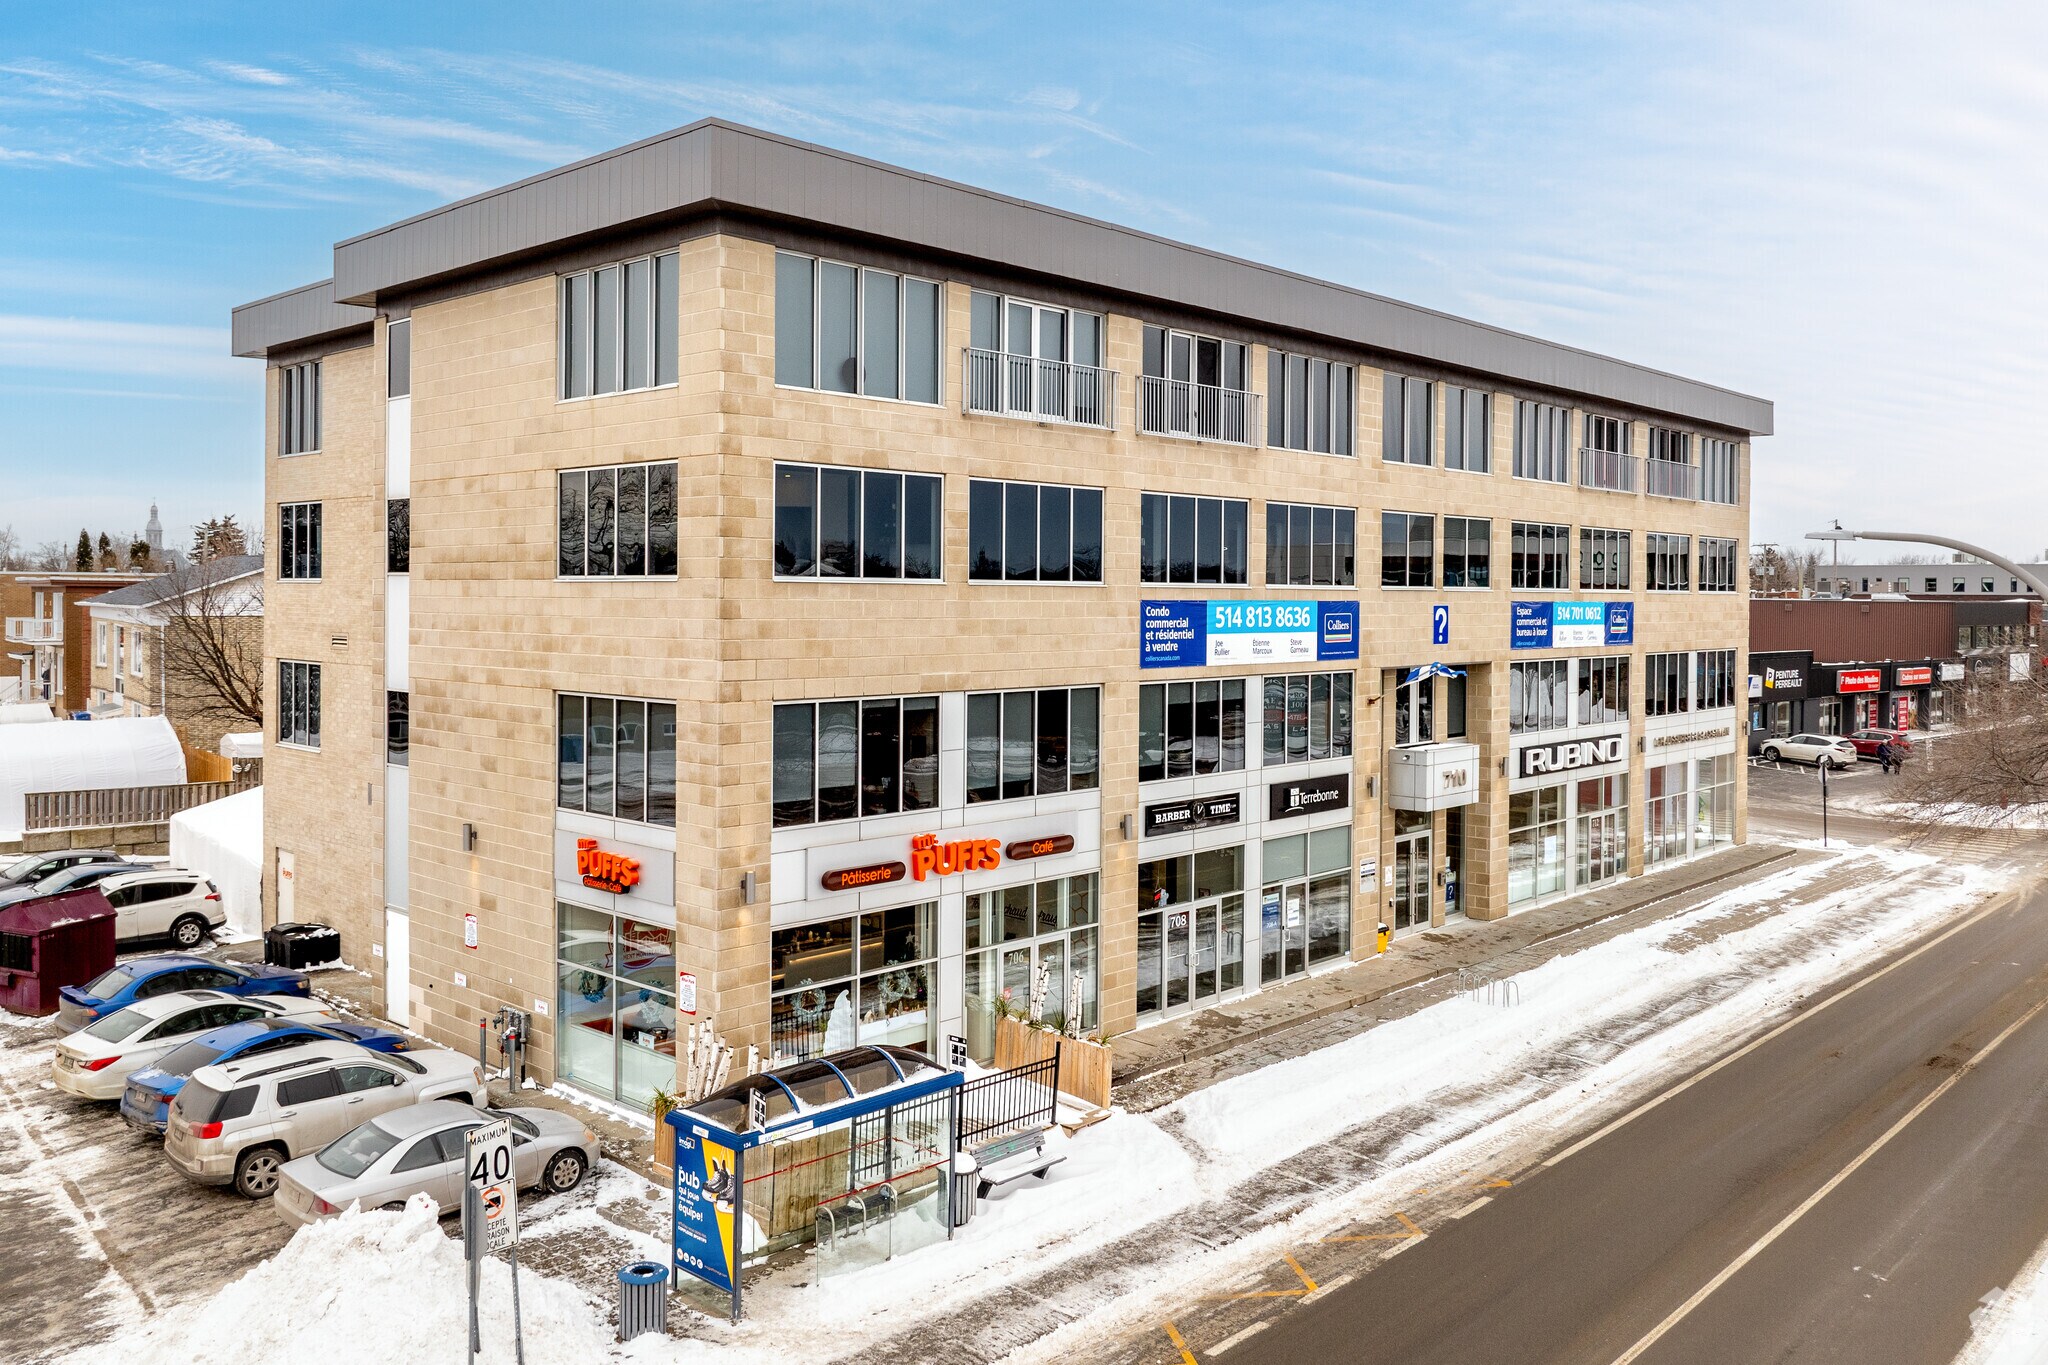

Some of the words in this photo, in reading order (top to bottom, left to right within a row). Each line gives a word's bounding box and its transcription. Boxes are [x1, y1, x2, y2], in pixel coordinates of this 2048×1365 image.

[1146, 606, 1170, 616] Condo
[1215, 606, 1242, 628] 514
[1246, 606, 1272, 628] 813
[1276, 606, 1310, 627] 8636
[1516, 607, 1532, 617] Espace
[1558, 607, 1570, 620] 514
[1572, 607, 1583, 620] 701
[1585, 607, 1601, 620] 0612
[1146, 617, 1188, 628] commercial
[1328, 620, 1349, 630] Colliers
[1516, 617, 1541, 626] commercial
[1146, 630, 1154, 640] et
[1156, 629, 1194, 640] résidentiel
[1516, 628, 1532, 636] bureau
[1536, 627, 1548, 636] louer
[1146, 641, 1150, 652] à
[1152, 641, 1178, 652] vendre
[1776, 670, 1799, 679] PEINTURE
[1775, 678, 1803, 689] PERREAULT
[1526, 737, 1622, 774] RUBINO
[1300, 788, 1338, 805] Terrebonne
[1156, 809, 1190, 823] BARBER
[1210, 803, 1231, 814] TIME
[1032, 840, 1053, 854] Café
[912, 839, 1001, 881] PUFFS
[577, 850, 639, 886] PUFFS
[842, 867, 891, 886] Pâtisserie
[1170, 914, 1187, 928] 708
[1009, 951, 1024, 966] 706
[470, 1126, 508, 1146] MAXIMUM
[471, 1145, 510, 1185] 40
[679, 1169, 700, 1189] pub
[678, 1186, 687, 1196] qui
[688, 1188, 699, 1201] joue
[678, 1201, 703, 1222] équipe!
[487, 1216, 506, 1231] CEPTÉ
[488, 1226, 510, 1240] RAISON
[487, 1237, 505, 1250] OCALE
